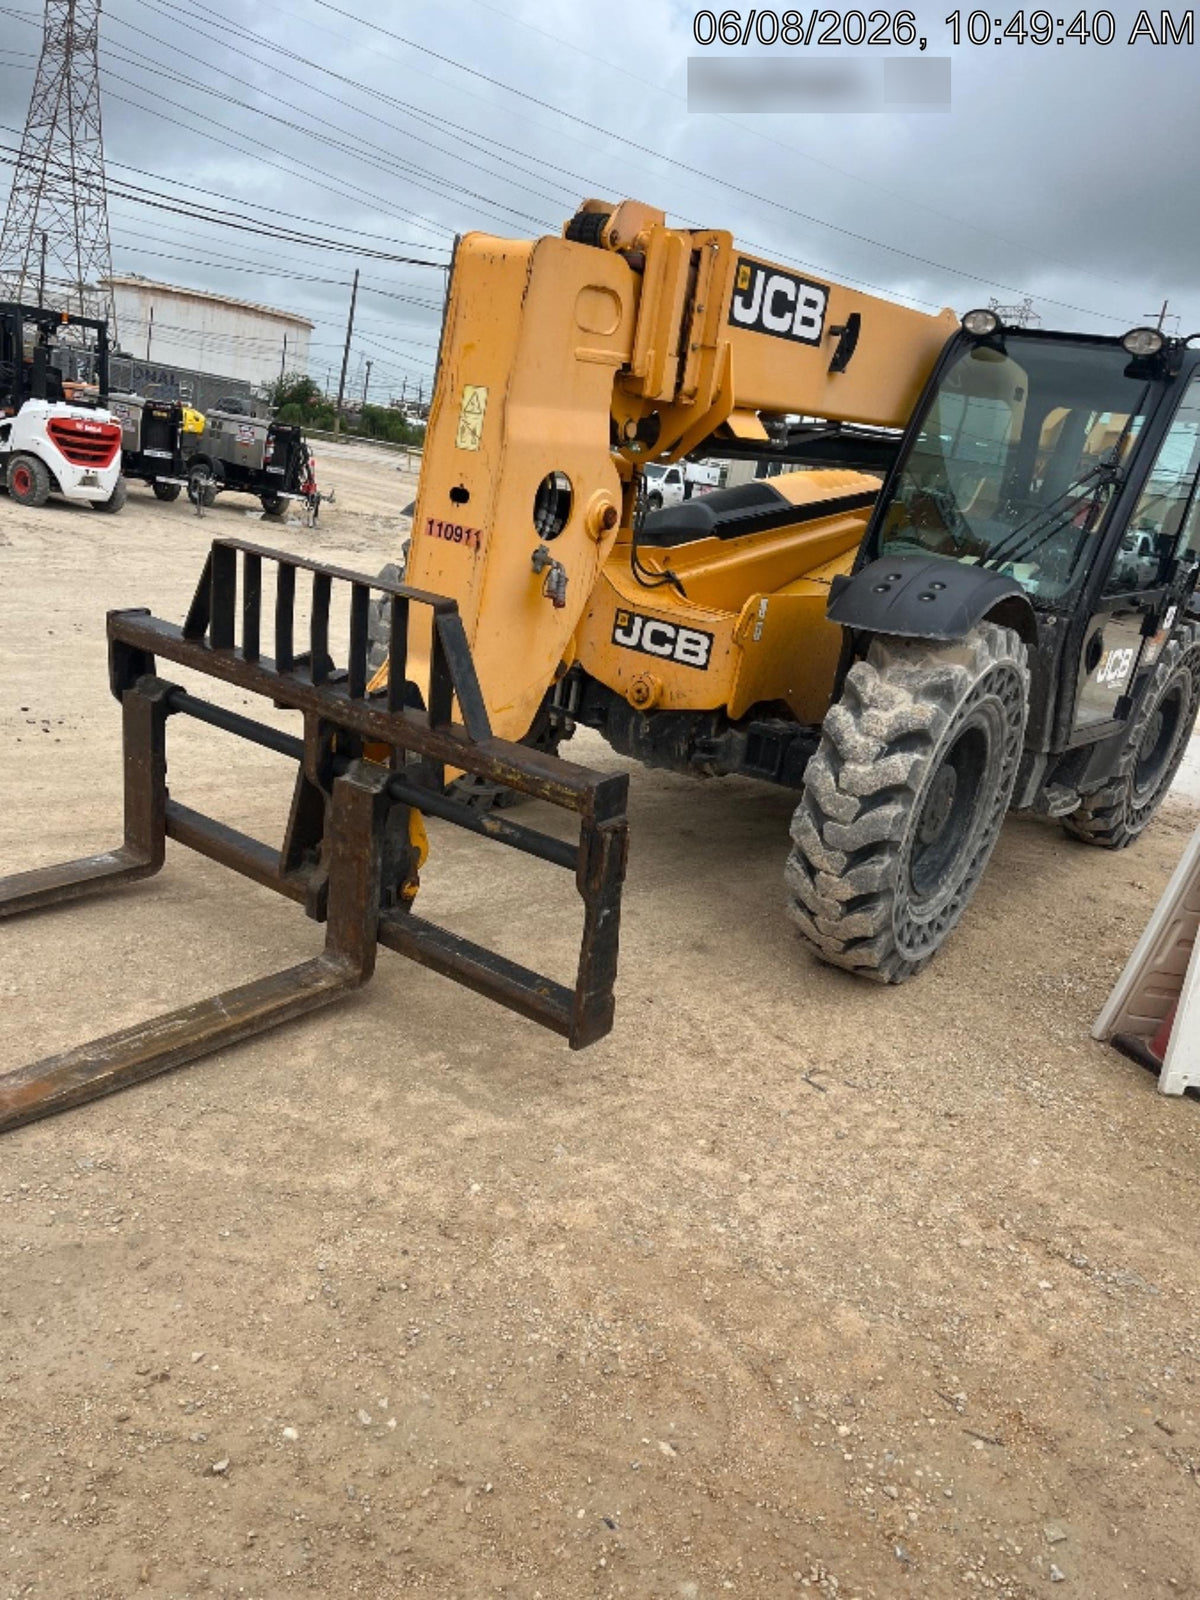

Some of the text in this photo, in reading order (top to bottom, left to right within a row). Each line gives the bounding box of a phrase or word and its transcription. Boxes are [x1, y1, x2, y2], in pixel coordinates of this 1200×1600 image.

[733, 269, 826, 340] JCB
[427, 518, 482, 552] 110911
[614, 615, 710, 666] JCB
[1096, 648, 1134, 684] JCB
